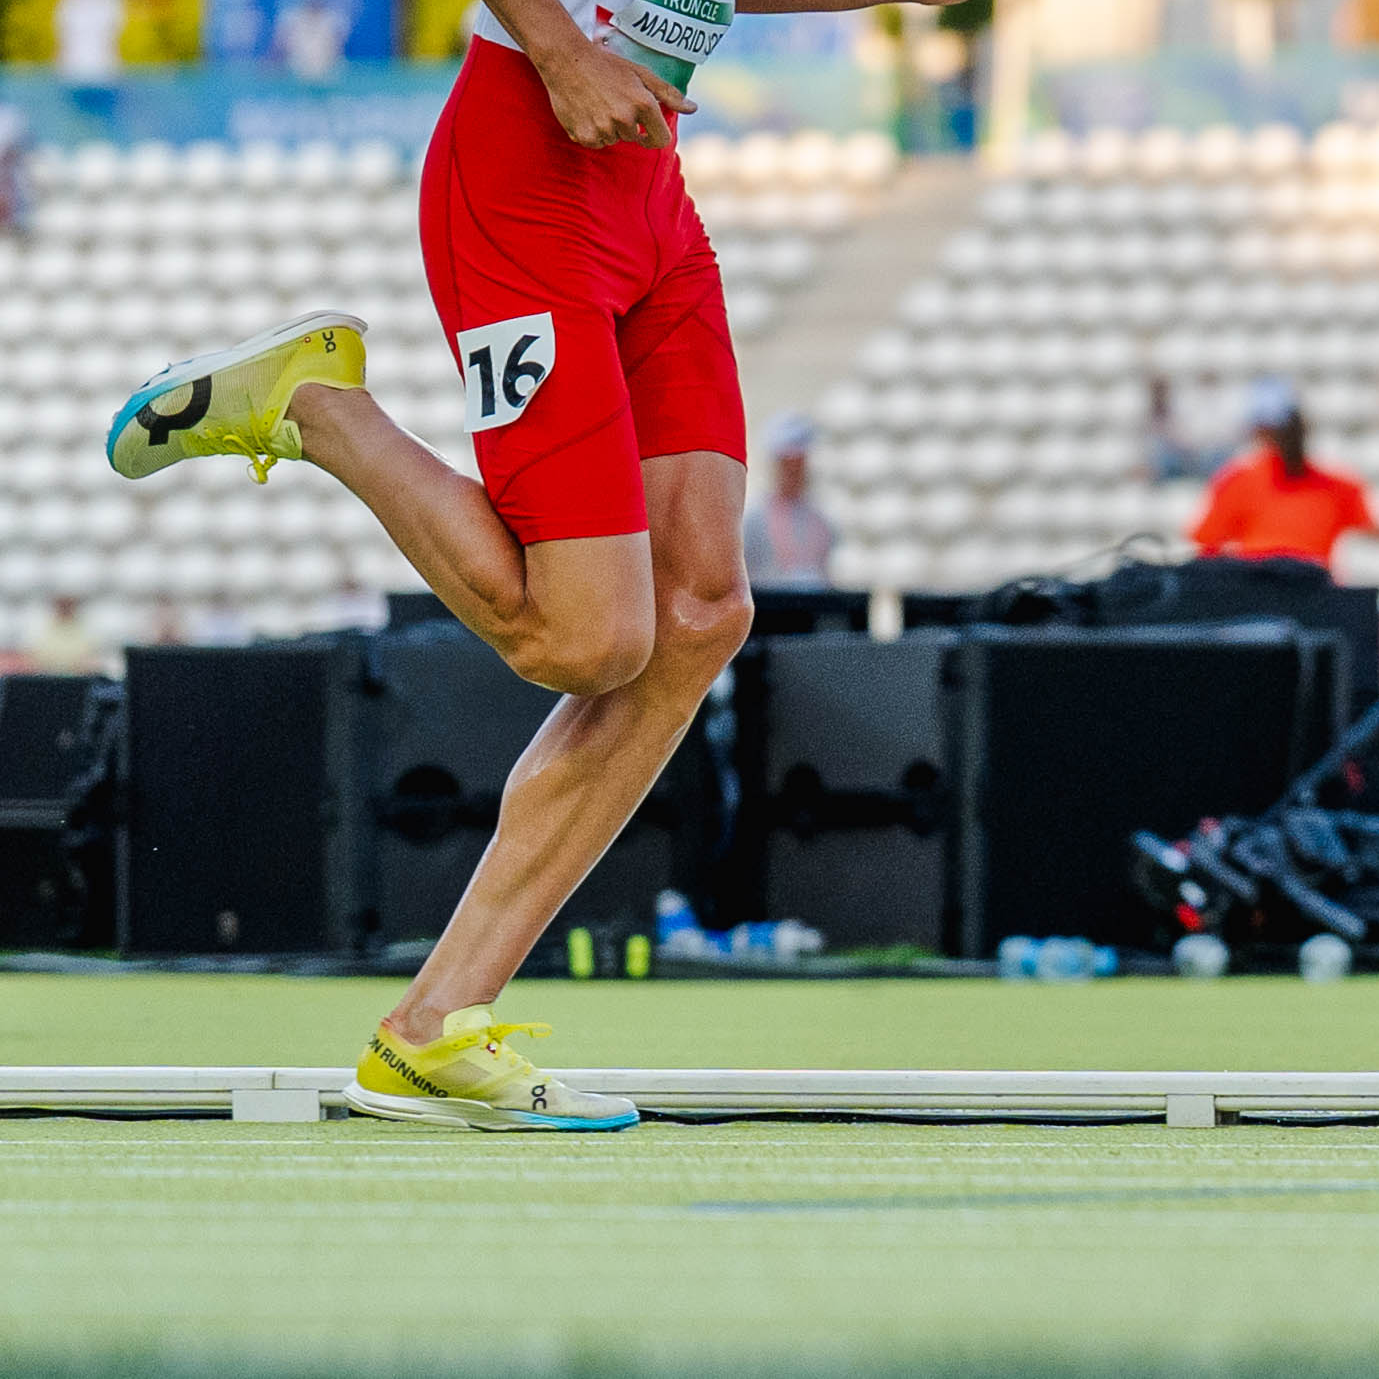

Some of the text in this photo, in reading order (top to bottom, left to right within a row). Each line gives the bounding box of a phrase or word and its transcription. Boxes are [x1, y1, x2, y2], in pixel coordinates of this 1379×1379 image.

[632, 11, 706, 53] MADRID
[468, 334, 546, 418] 16
[379, 1047, 449, 1098] RUNNING
